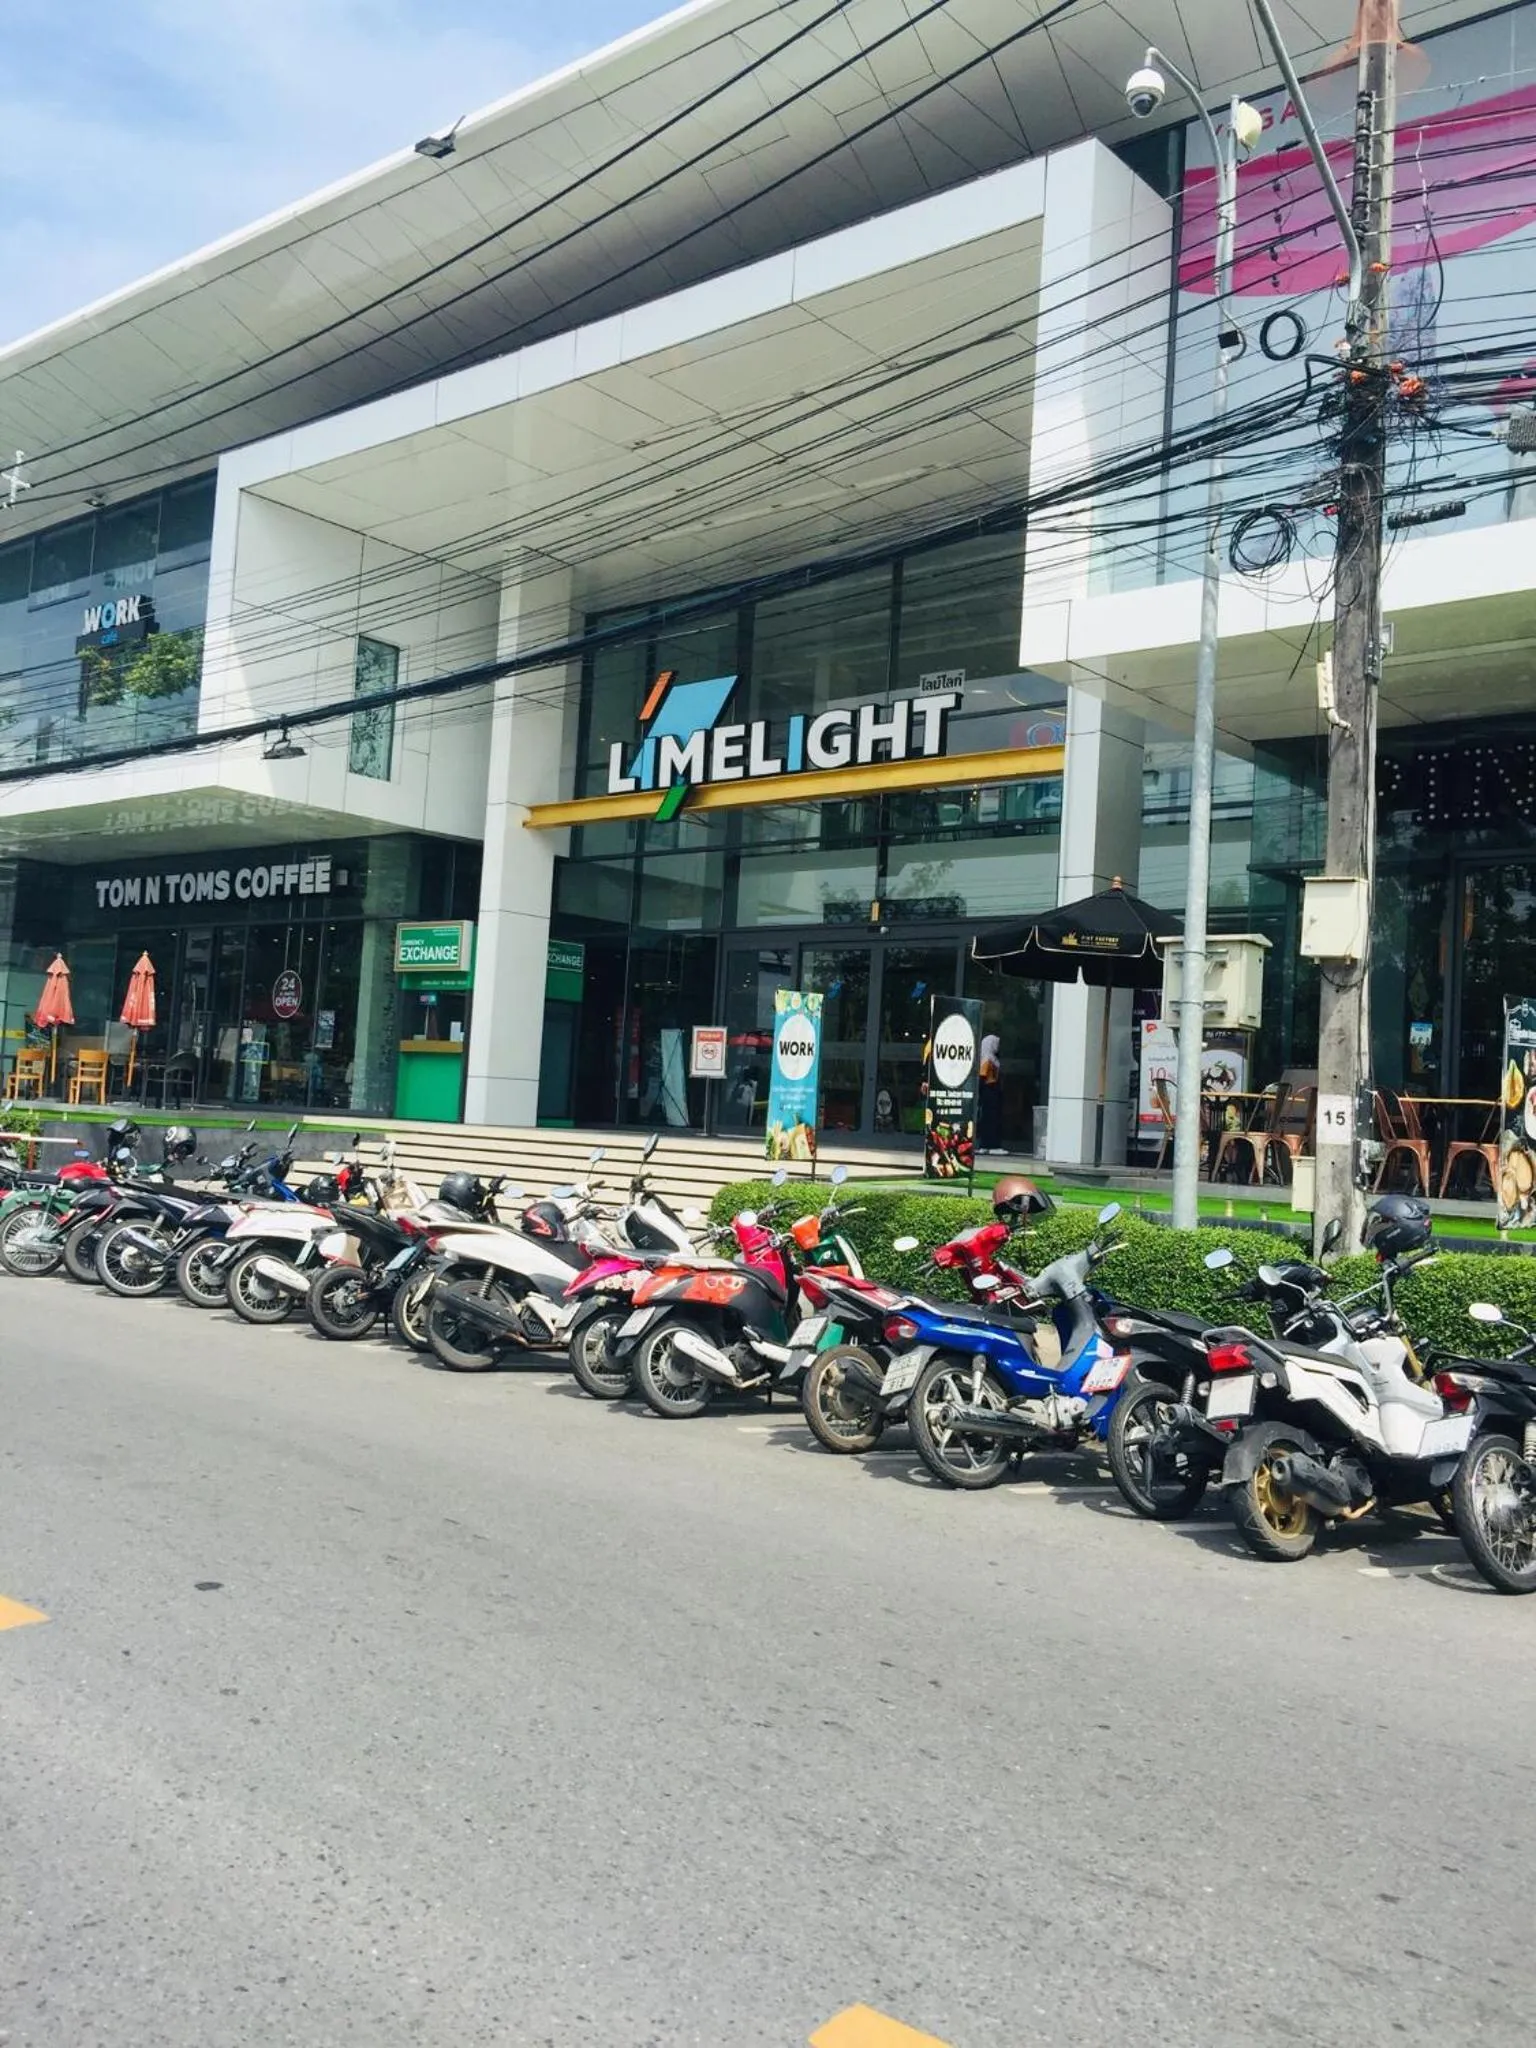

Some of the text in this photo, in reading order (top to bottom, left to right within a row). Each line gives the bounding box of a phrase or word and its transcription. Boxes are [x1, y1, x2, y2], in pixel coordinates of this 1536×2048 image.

[84, 595, 141, 634] WORK
[608, 693, 958, 795] LIMELIGHT
[96, 860, 332, 908] TOM N TOMS COFFEE
[400, 945, 459, 961] EXCHANGE
[280, 977, 296, 990] 24
[275, 996, 298, 1007] OPEN
[779, 1040, 815, 1056] WORK
[935, 1043, 972, 1061] WORK
[1324, 1110, 1346, 1126] 15
